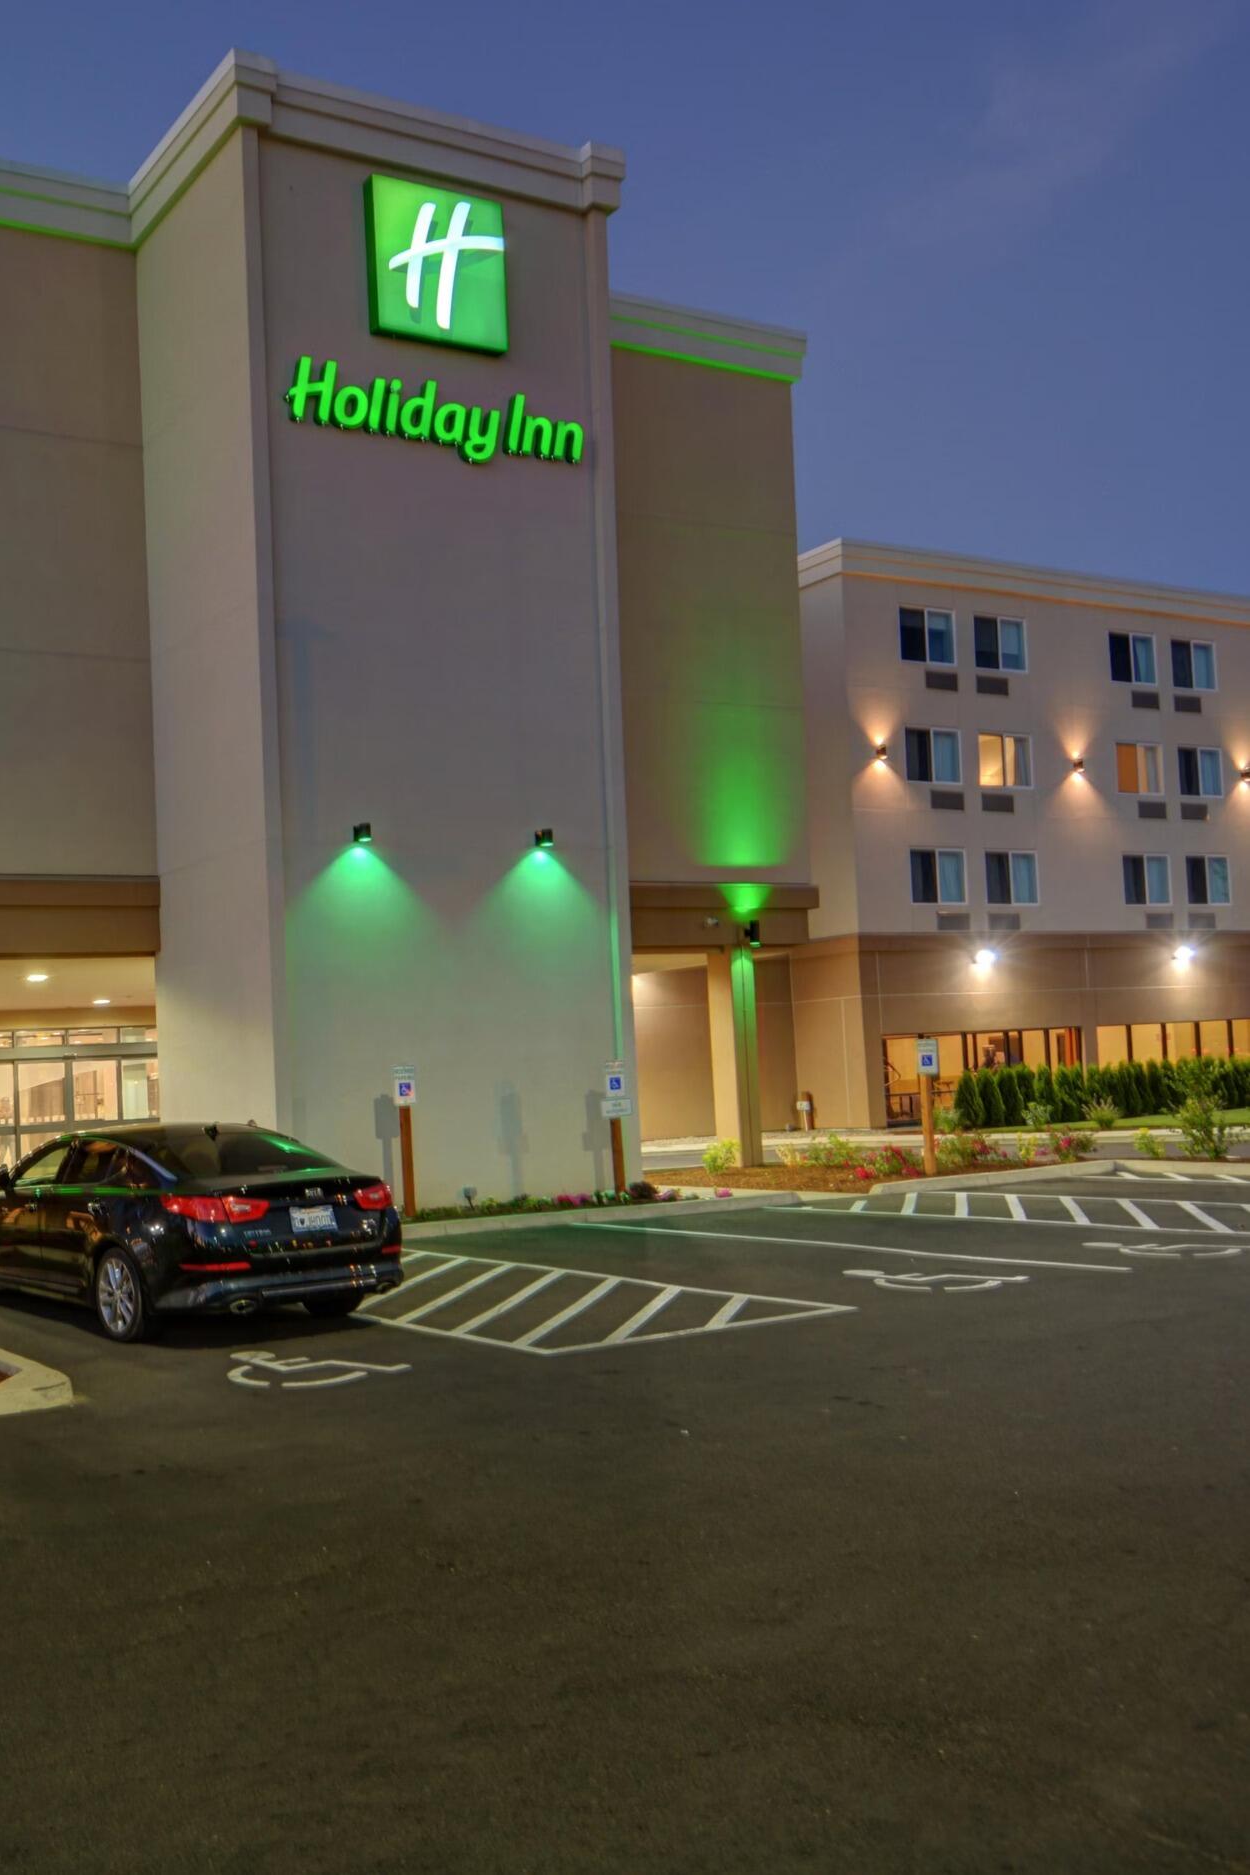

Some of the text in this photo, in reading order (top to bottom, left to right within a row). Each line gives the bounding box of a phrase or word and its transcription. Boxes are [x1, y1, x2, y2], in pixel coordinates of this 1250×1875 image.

[388, 201, 505, 330] H
[287, 355, 584, 463] Holiday Inn
